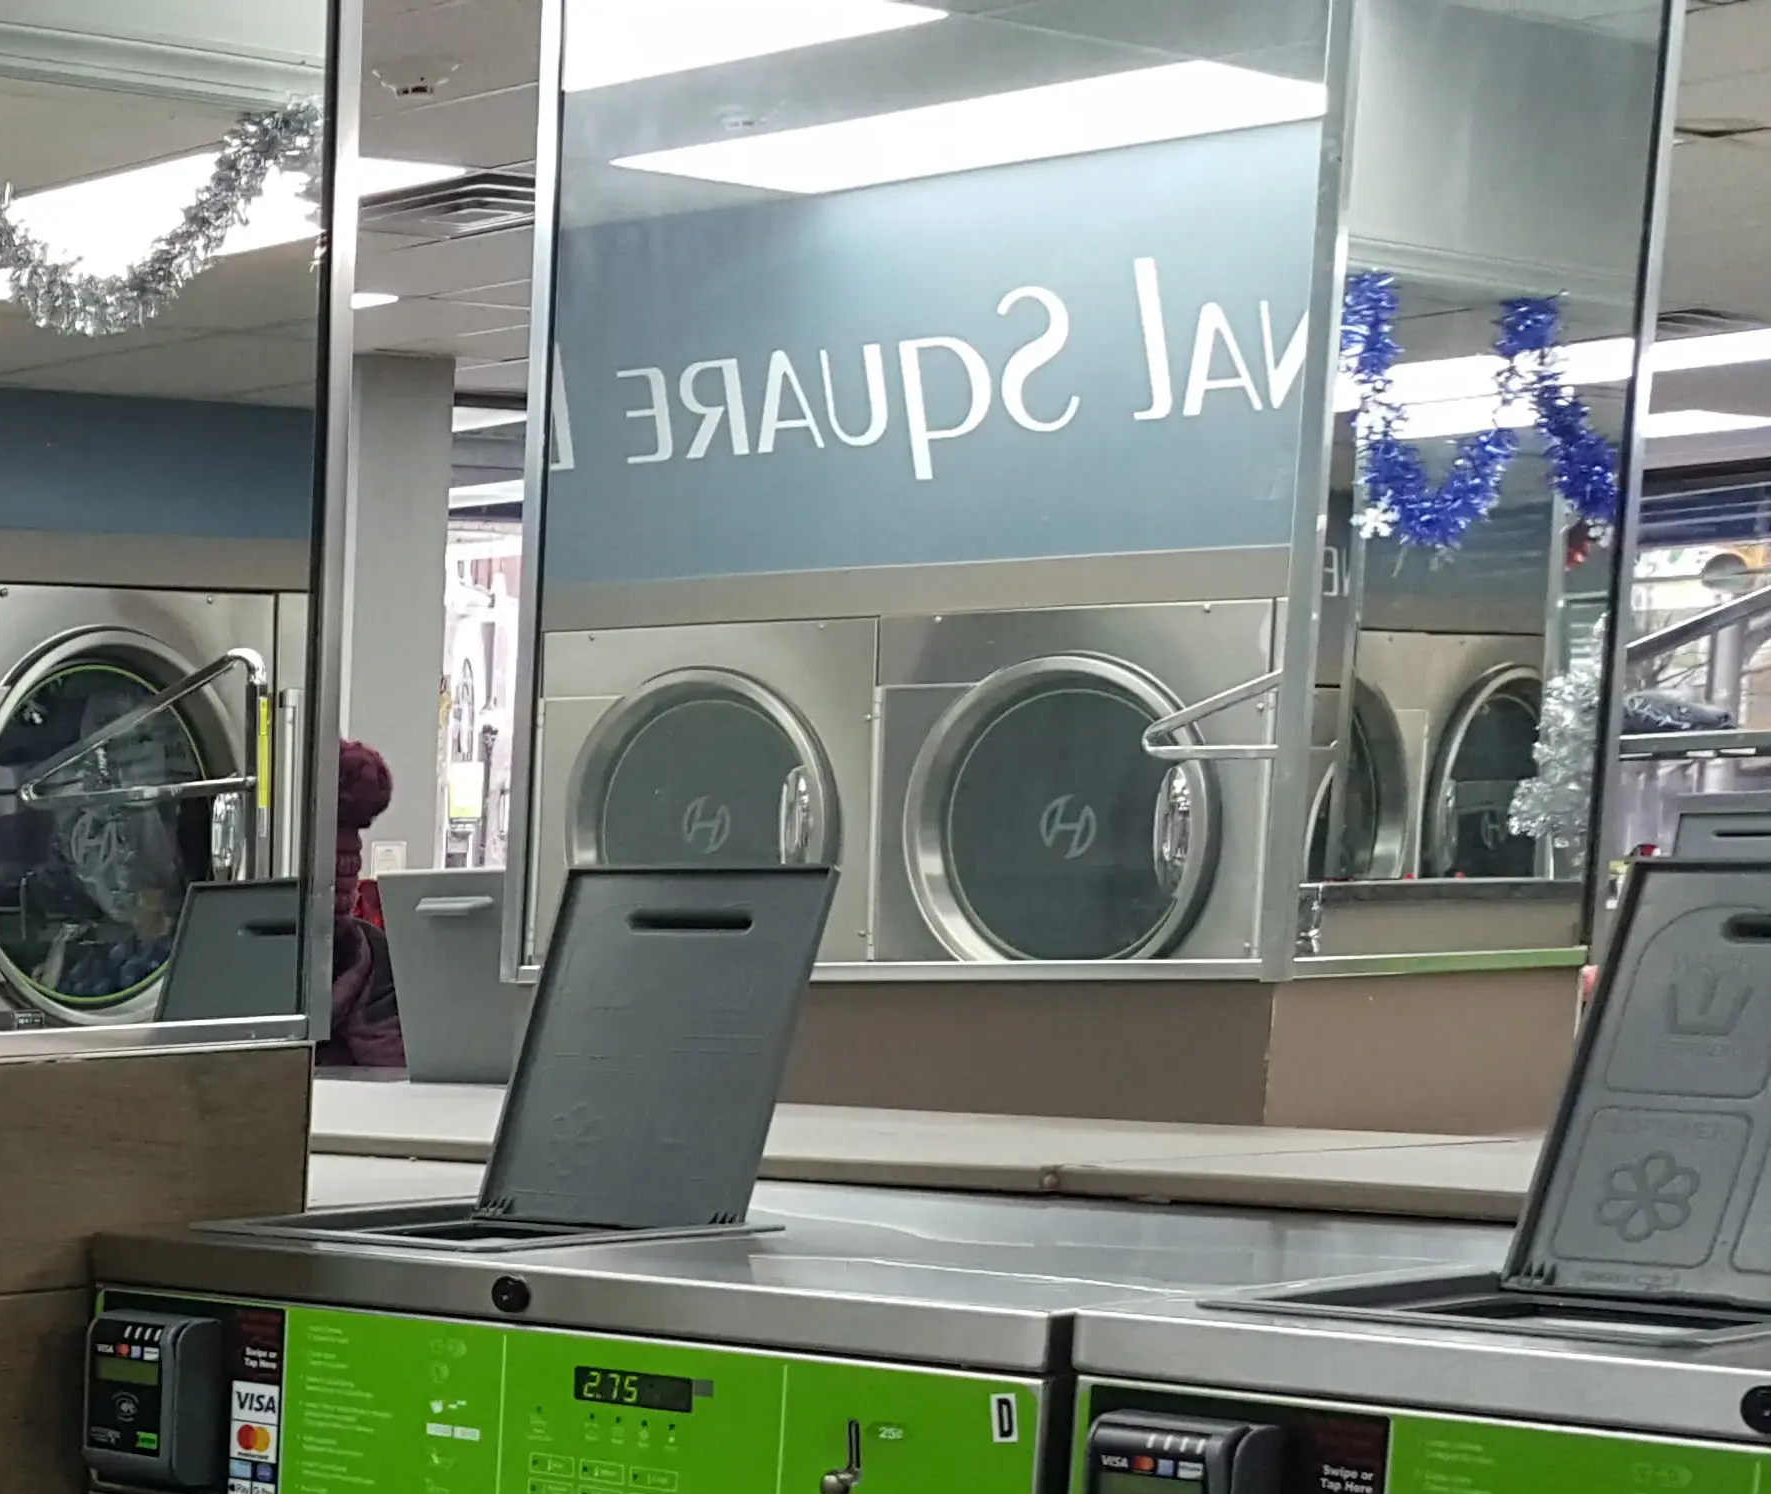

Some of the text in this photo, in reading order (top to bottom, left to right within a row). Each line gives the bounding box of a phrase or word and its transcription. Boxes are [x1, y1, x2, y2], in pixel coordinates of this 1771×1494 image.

[97, 1343, 114, 1354] VISA
[583, 1371, 640, 1403] 2.75
[236, 1391, 276, 1414] VISA
[997, 1397, 1014, 1438] D
[1100, 1454, 1129, 1468] VISA
[1322, 1464, 1374, 1481] Swipe or
[1320, 1478, 1373, 1494] Tap Here
